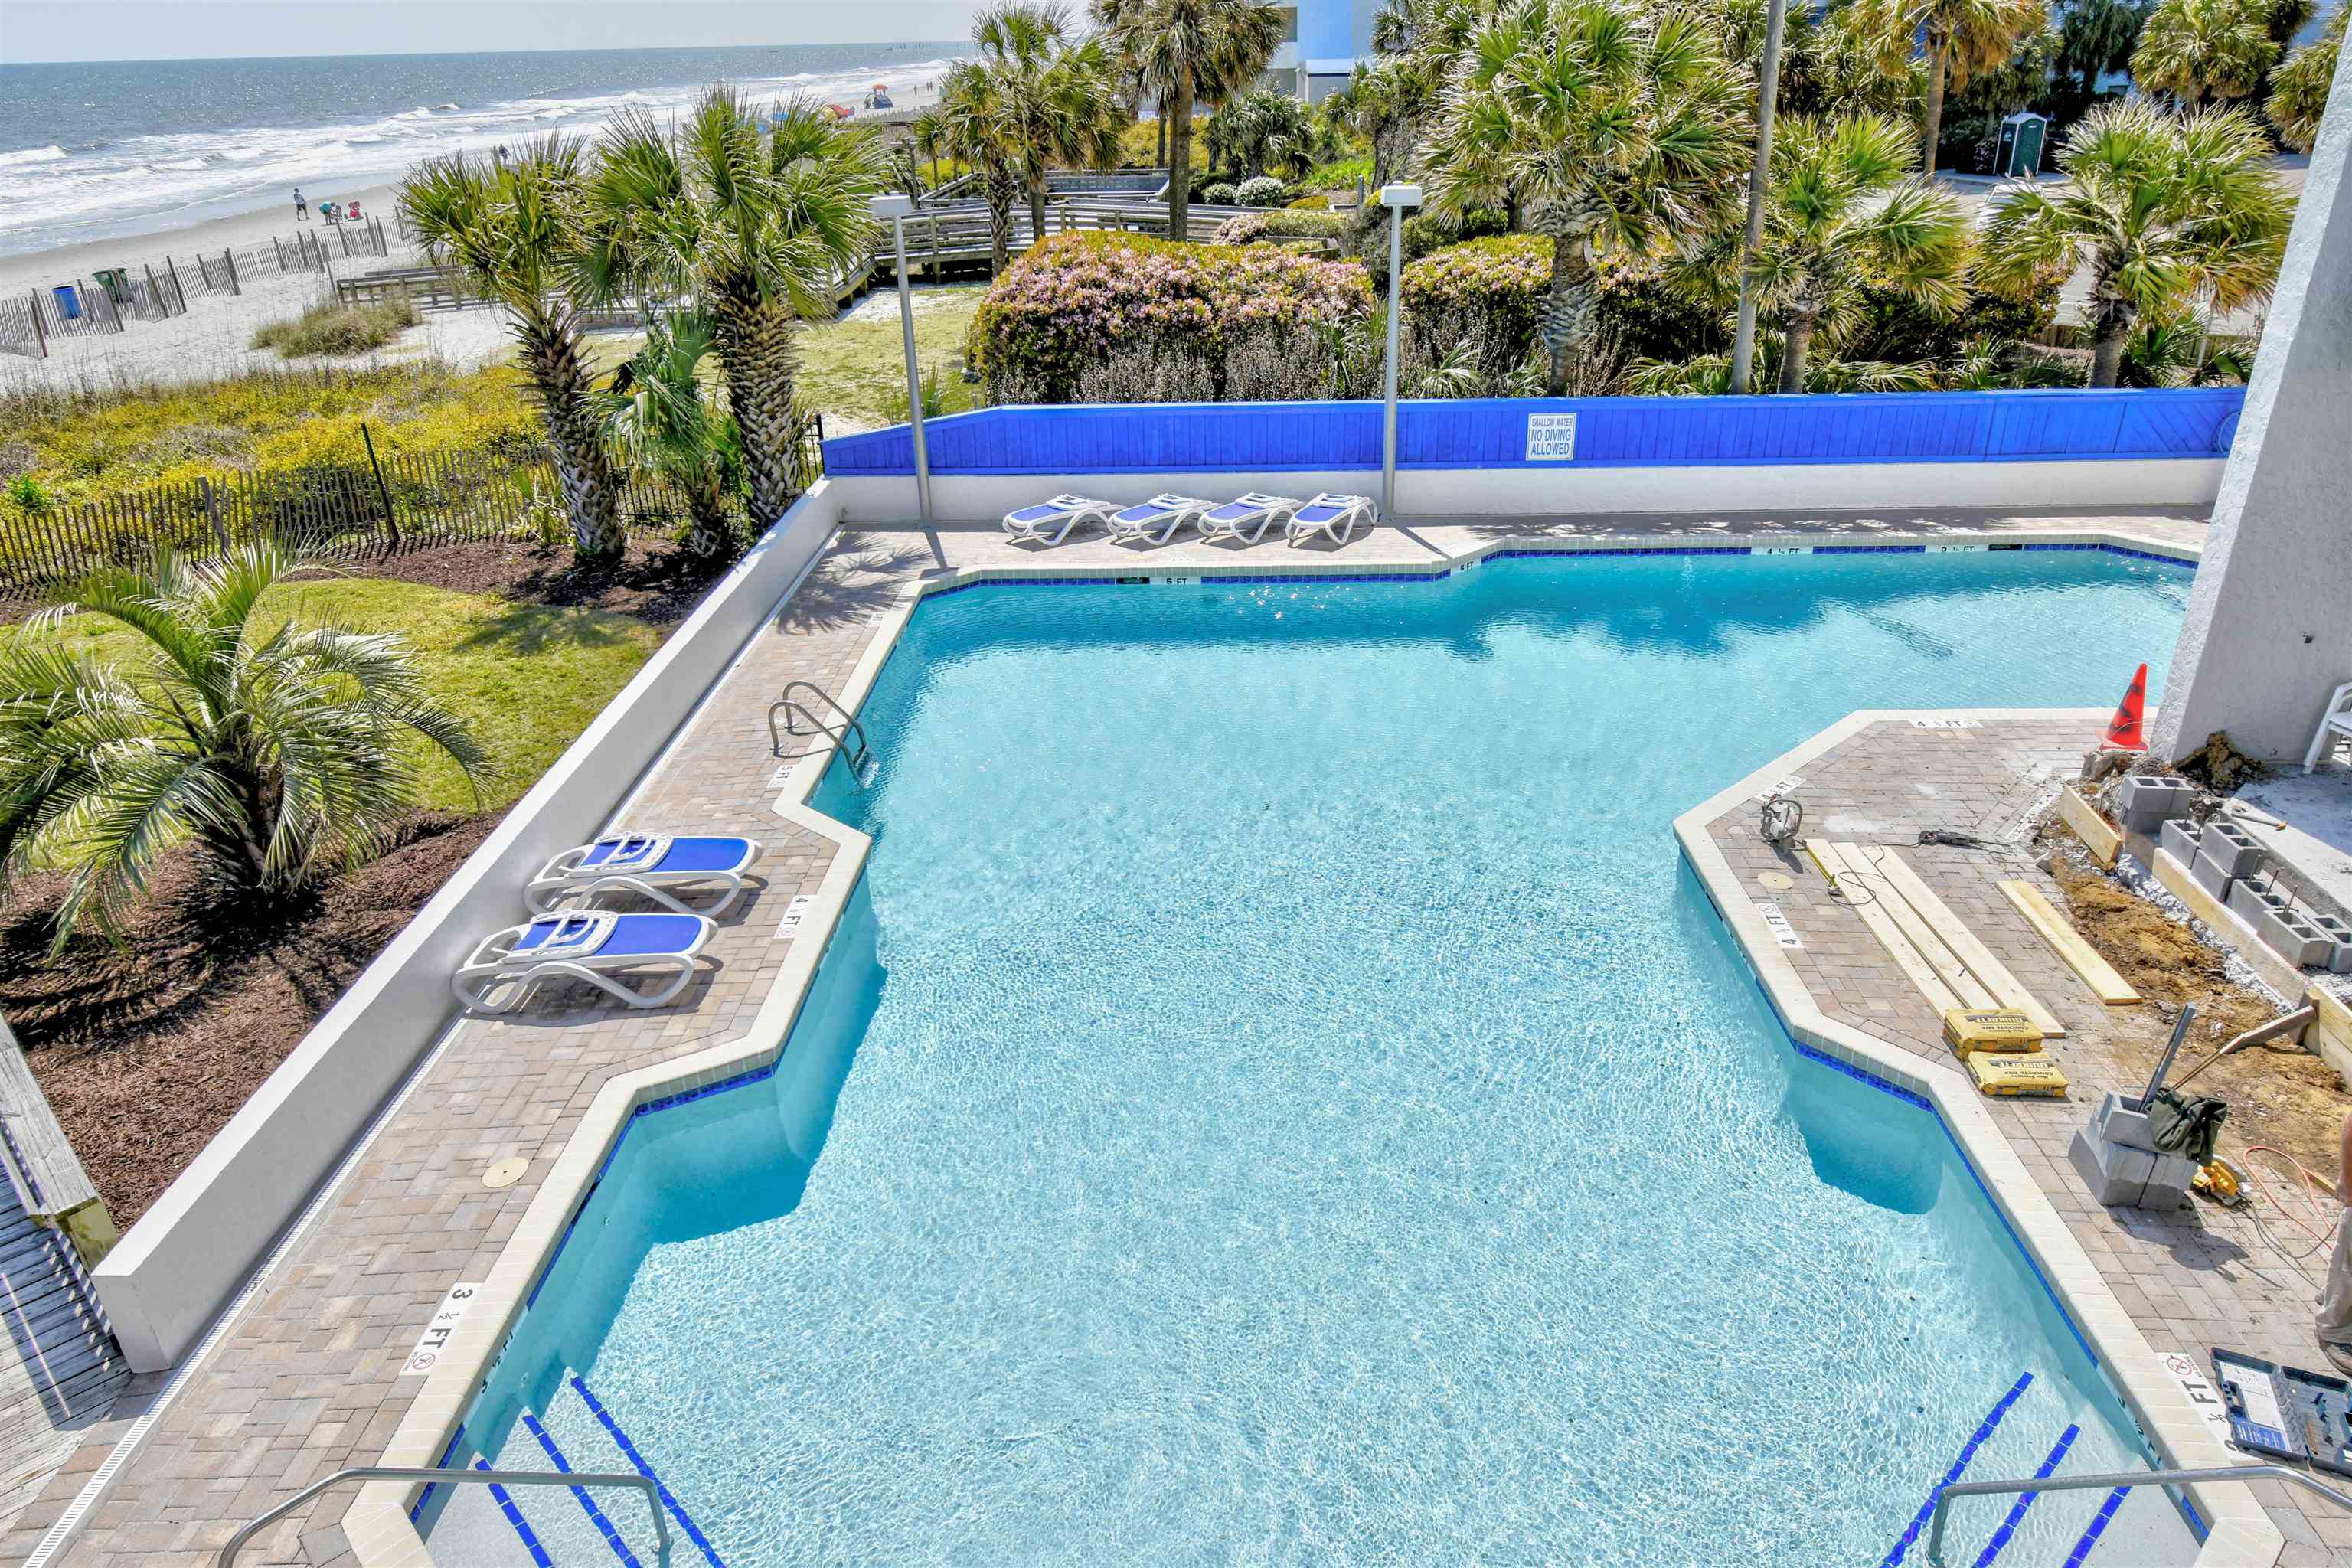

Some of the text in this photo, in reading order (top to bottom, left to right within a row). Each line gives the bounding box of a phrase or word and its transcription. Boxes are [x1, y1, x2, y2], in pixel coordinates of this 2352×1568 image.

[1531, 417, 1573, 426] SHALLOW WATER
[1531, 429, 1571, 441] NO DIVING
[1531, 443, 1570, 455] ALLOWED
[783, 916, 802, 926] FT
[1765, 915, 1786, 925] FT
[452, 1289, 473, 1298] 3
[422, 1328, 452, 1348] FT
[2180, 1380, 2217, 1403] FT
